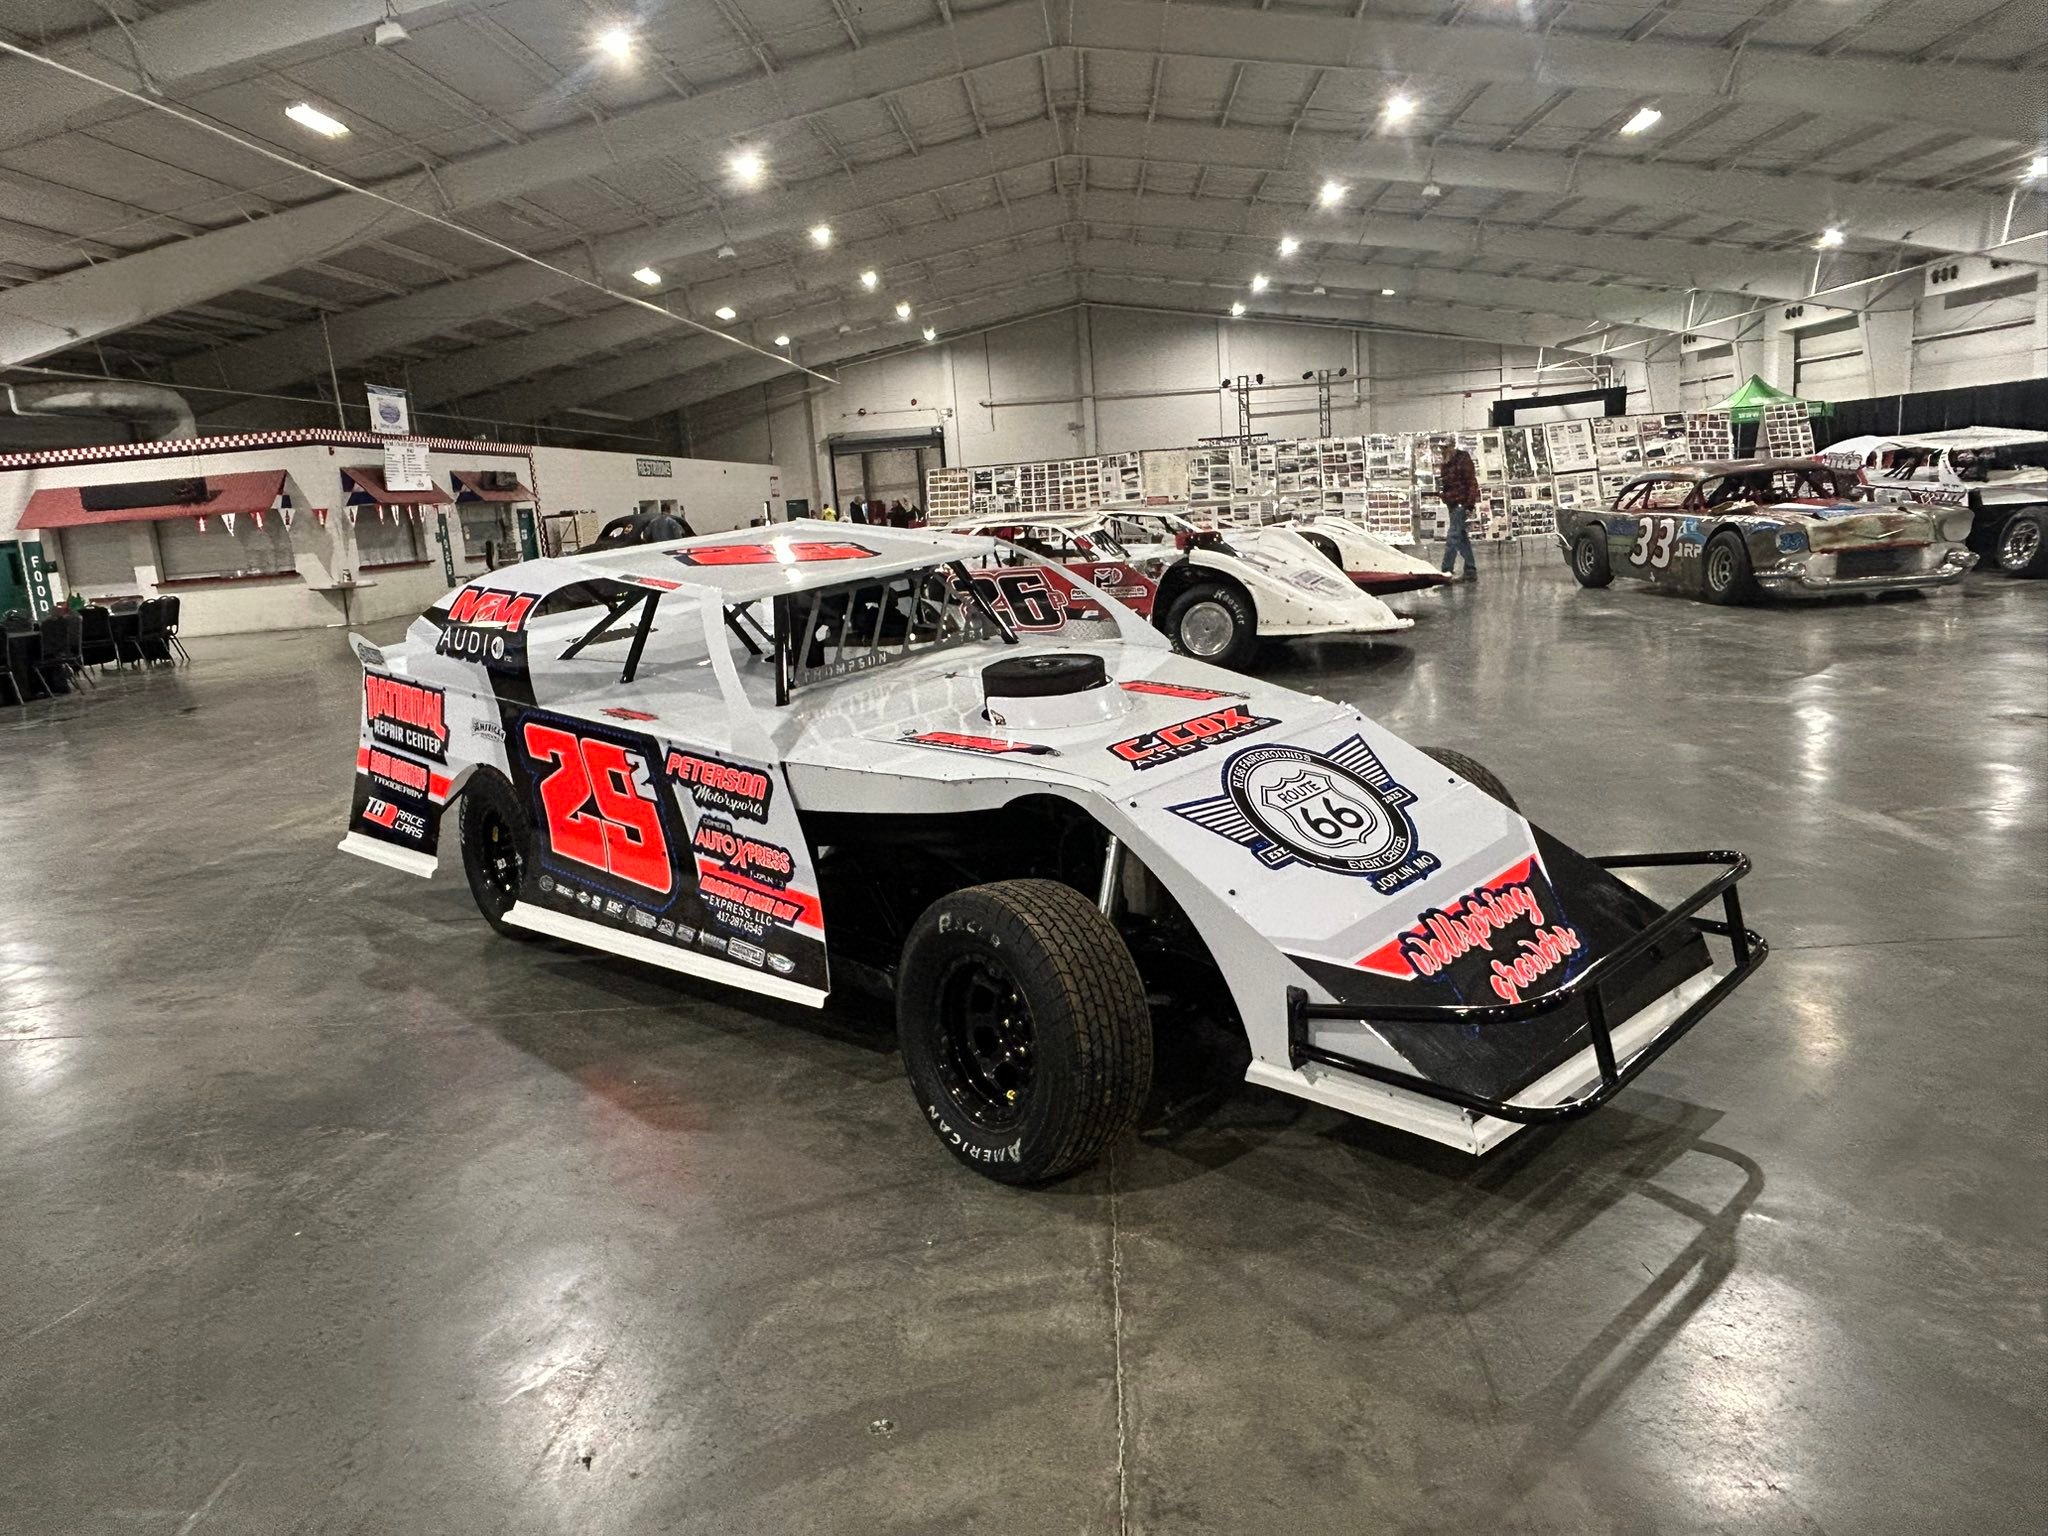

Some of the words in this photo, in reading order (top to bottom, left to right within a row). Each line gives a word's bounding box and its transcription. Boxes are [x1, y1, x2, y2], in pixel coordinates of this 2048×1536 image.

[1630, 516, 1675, 568] 33
[30, 555, 50, 612] FOOD
[439, 625, 505, 660] AUDIO
[803, 652, 888, 683] THOMPSON
[373, 719, 404, 743] REPAIR
[405, 729, 441, 754] CENTER
[1136, 744, 1196, 767] AUTO
[665, 751, 768, 801] PETERSON
[1277, 779, 1321, 804] ROUTE
[523, 722, 673, 895] 25
[692, 783, 763, 816] Motorsports
[394, 820, 425, 839] CARS
[396, 809, 426, 828] RACE
[1299, 796, 1365, 840] 66
[1347, 858, 1385, 870] EVENT
[1376, 864, 1420, 890] JOPLIN,
[1412, 854, 1435, 870] MO
[754, 911, 773, 927] LLC
[927, 1104, 1022, 1163] AMERICAN
